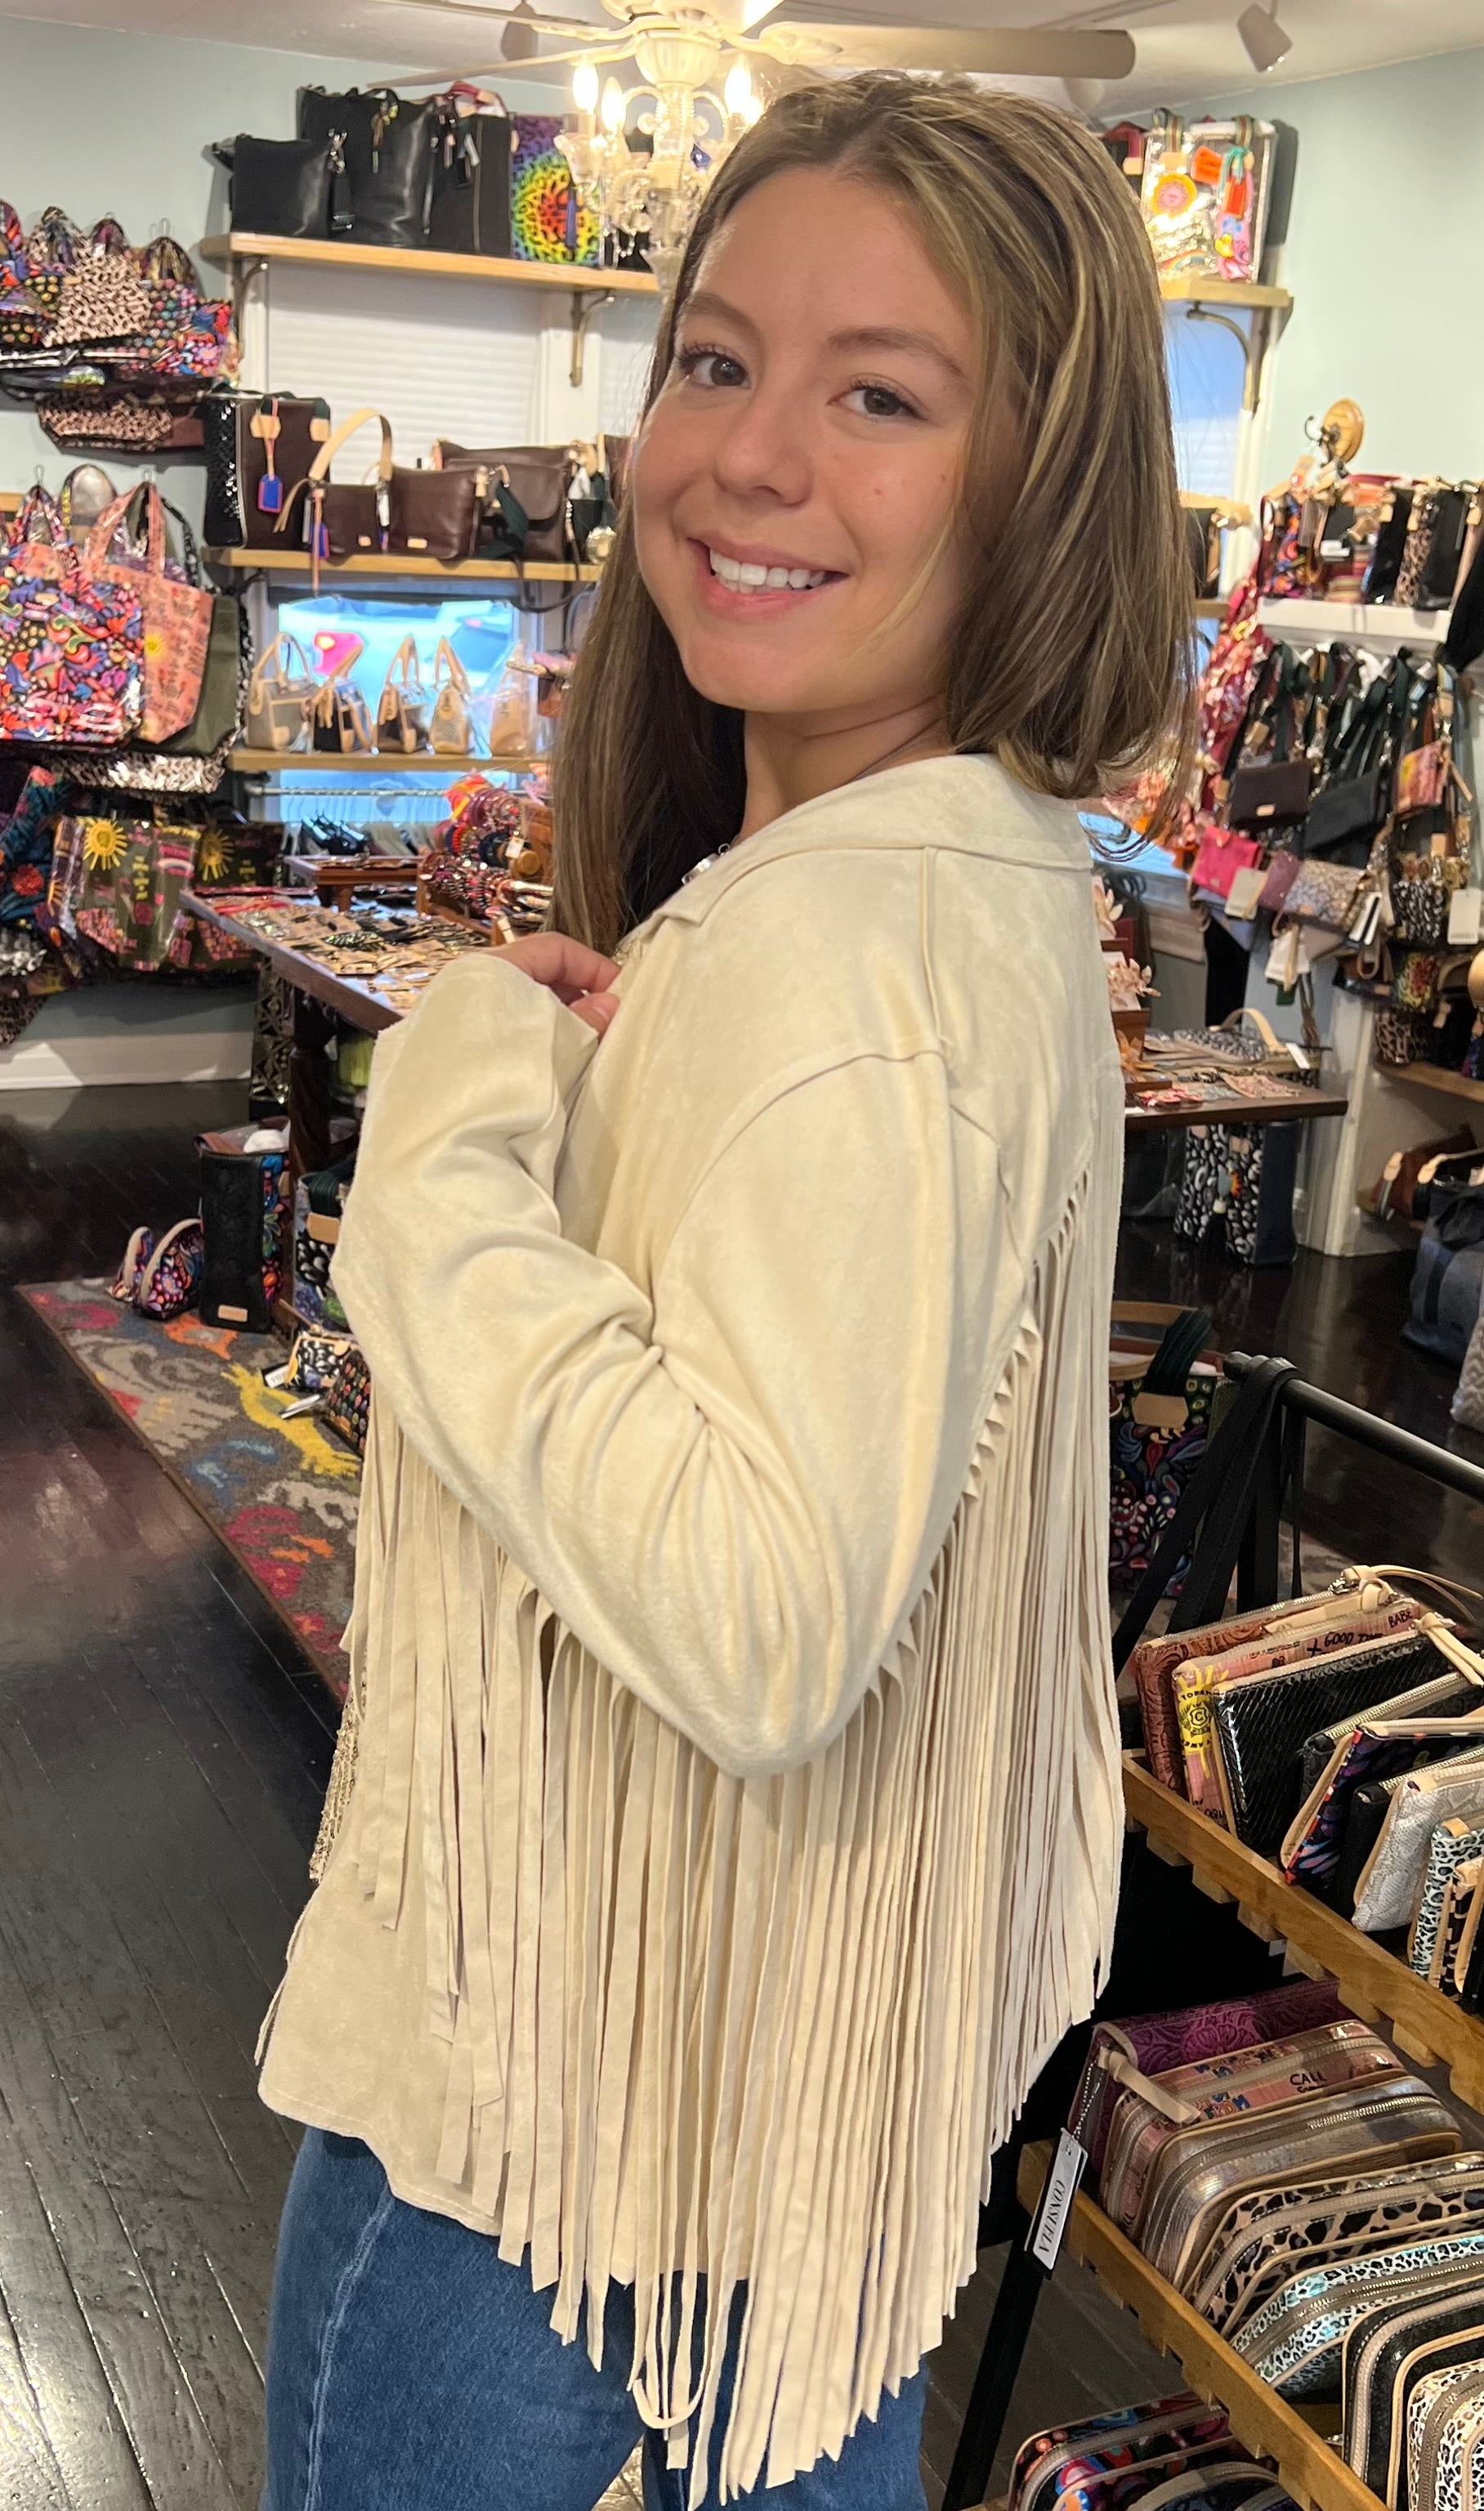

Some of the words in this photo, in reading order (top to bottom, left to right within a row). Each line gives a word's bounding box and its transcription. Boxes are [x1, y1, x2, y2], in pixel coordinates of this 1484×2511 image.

[1324, 1631, 1354, 1648] GOOD
[1290, 2070, 1327, 2086] CALL
[1039, 2179, 1066, 2253] CONSUELA
